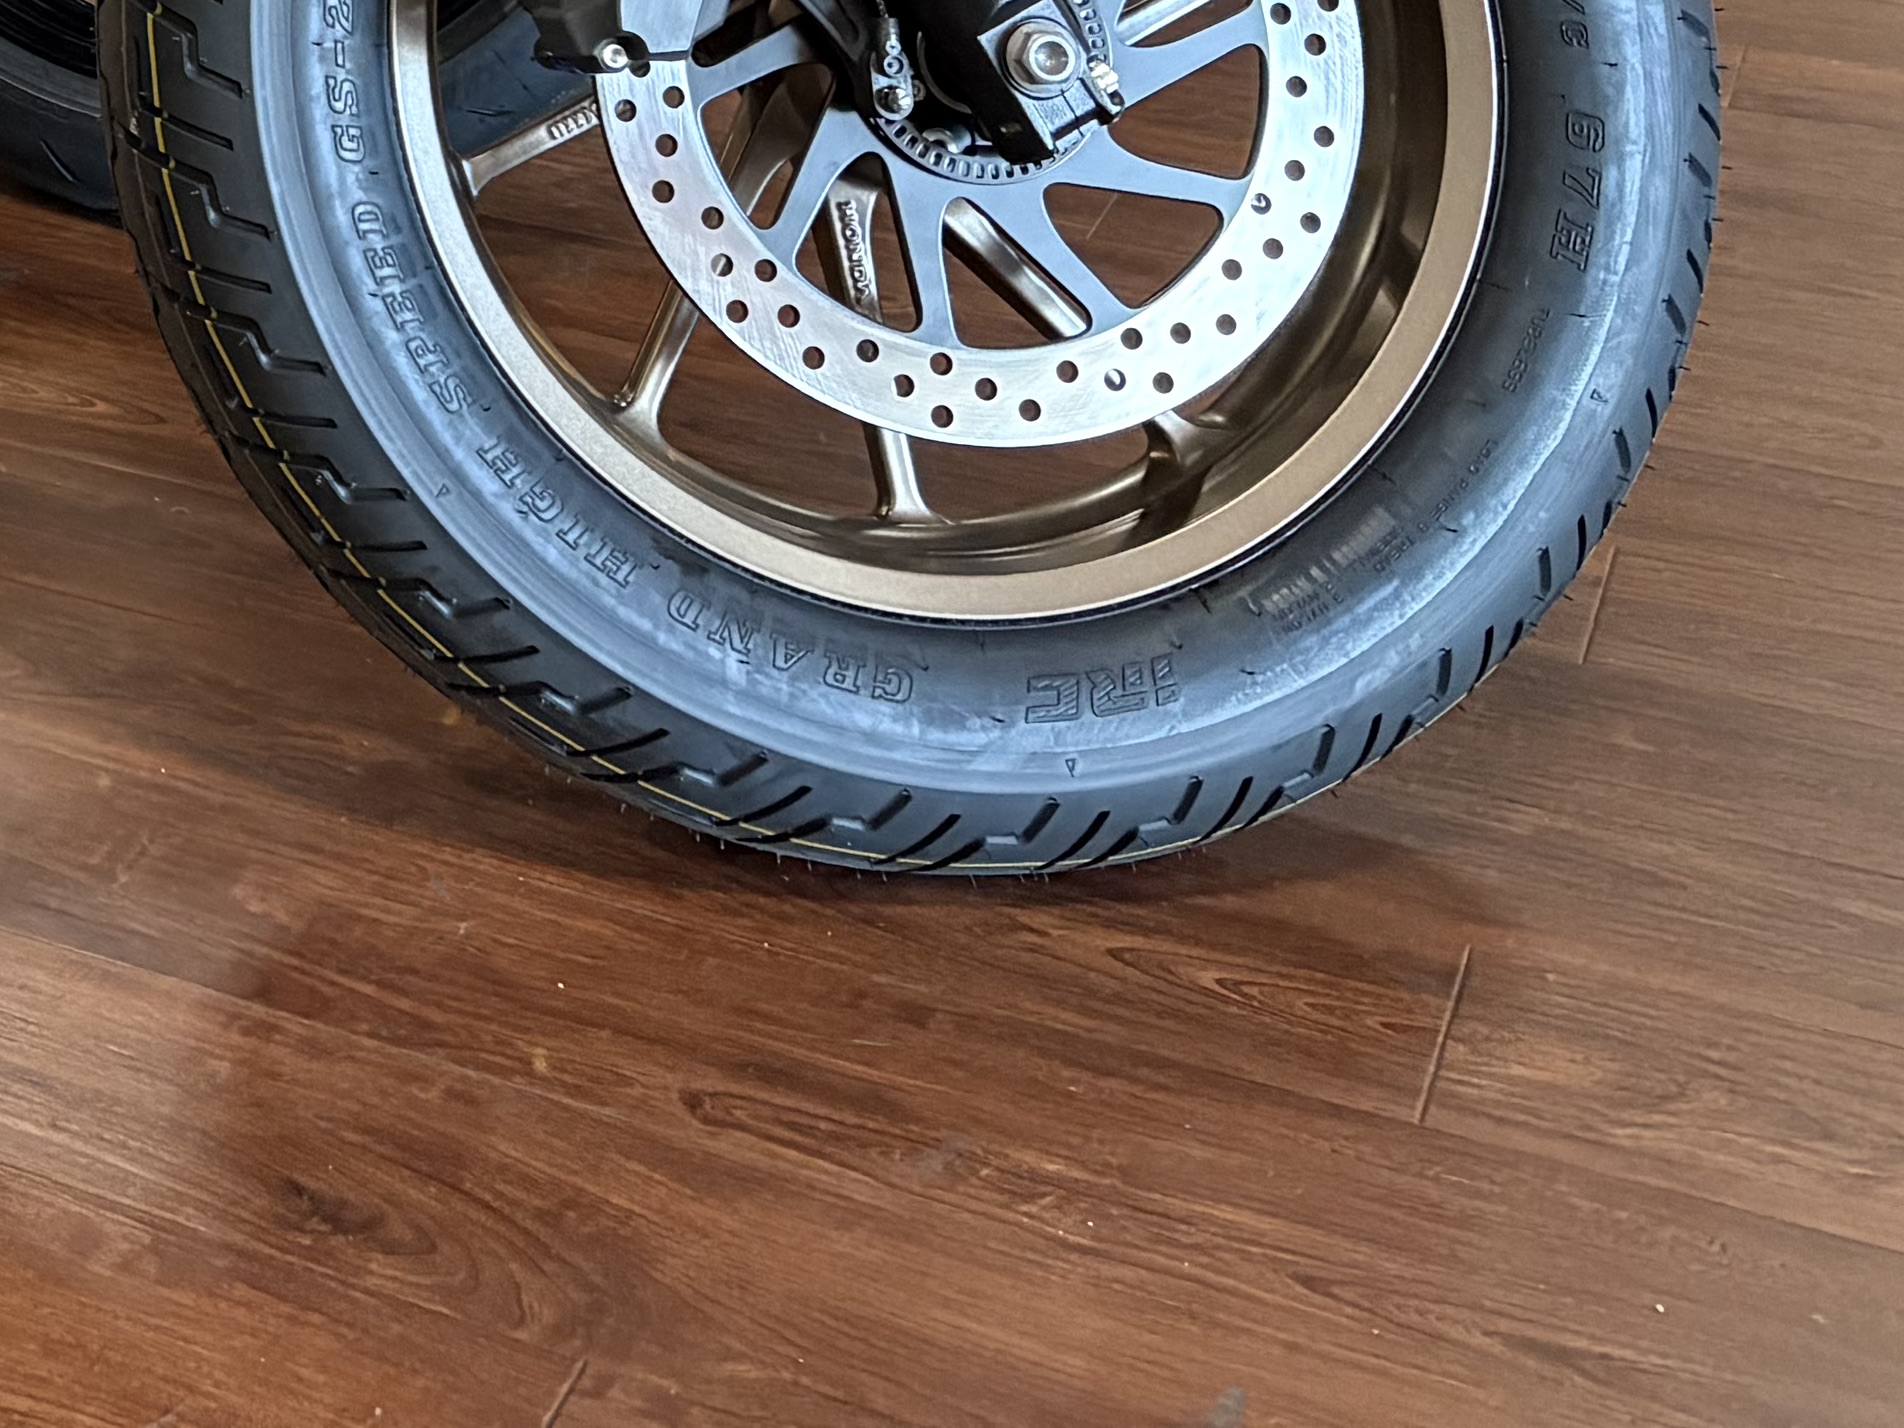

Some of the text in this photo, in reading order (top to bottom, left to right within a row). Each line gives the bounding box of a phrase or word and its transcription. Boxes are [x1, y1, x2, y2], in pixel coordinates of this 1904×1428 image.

[1550, 110, 1606, 273] 67H
[351, 201, 476, 414] SPEED
[478, 433, 641, 590] HIGH
[668, 585, 914, 705] GRAND
